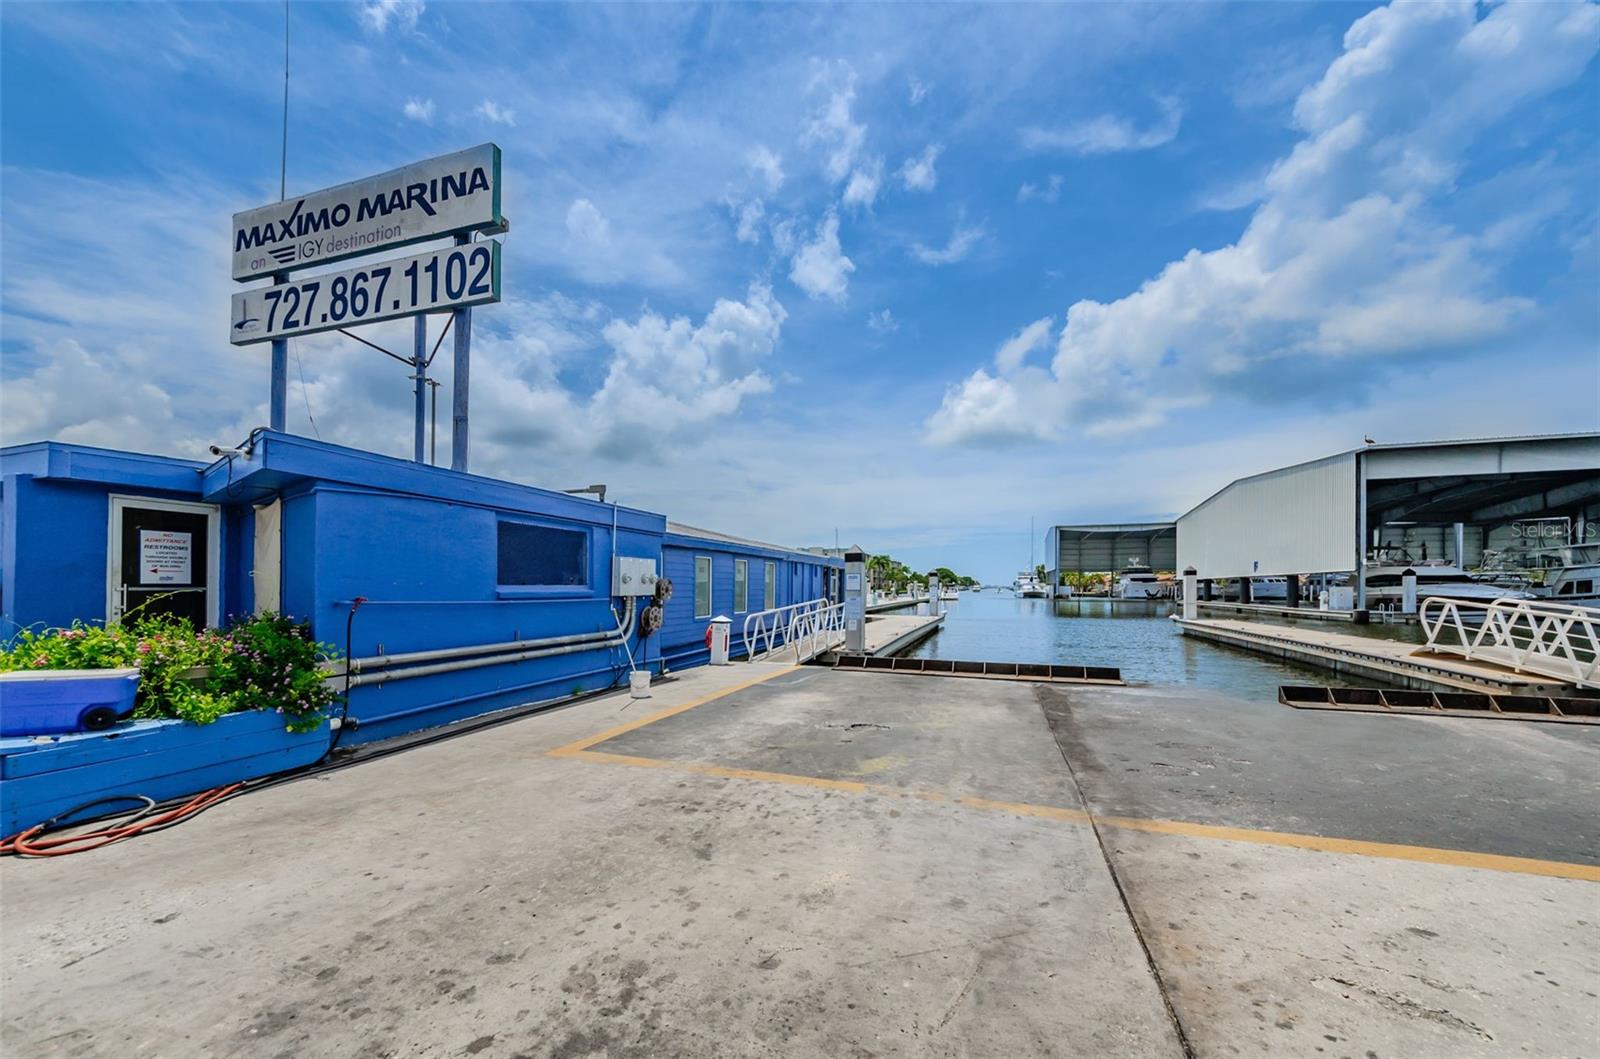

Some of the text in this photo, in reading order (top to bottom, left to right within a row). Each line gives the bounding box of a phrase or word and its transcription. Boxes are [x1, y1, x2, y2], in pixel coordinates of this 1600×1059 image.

[235, 167, 489, 252] MAXIMO MARINA
[251, 223, 402, 271] an IGY destination
[264, 247, 491, 332] 727.867.1102
